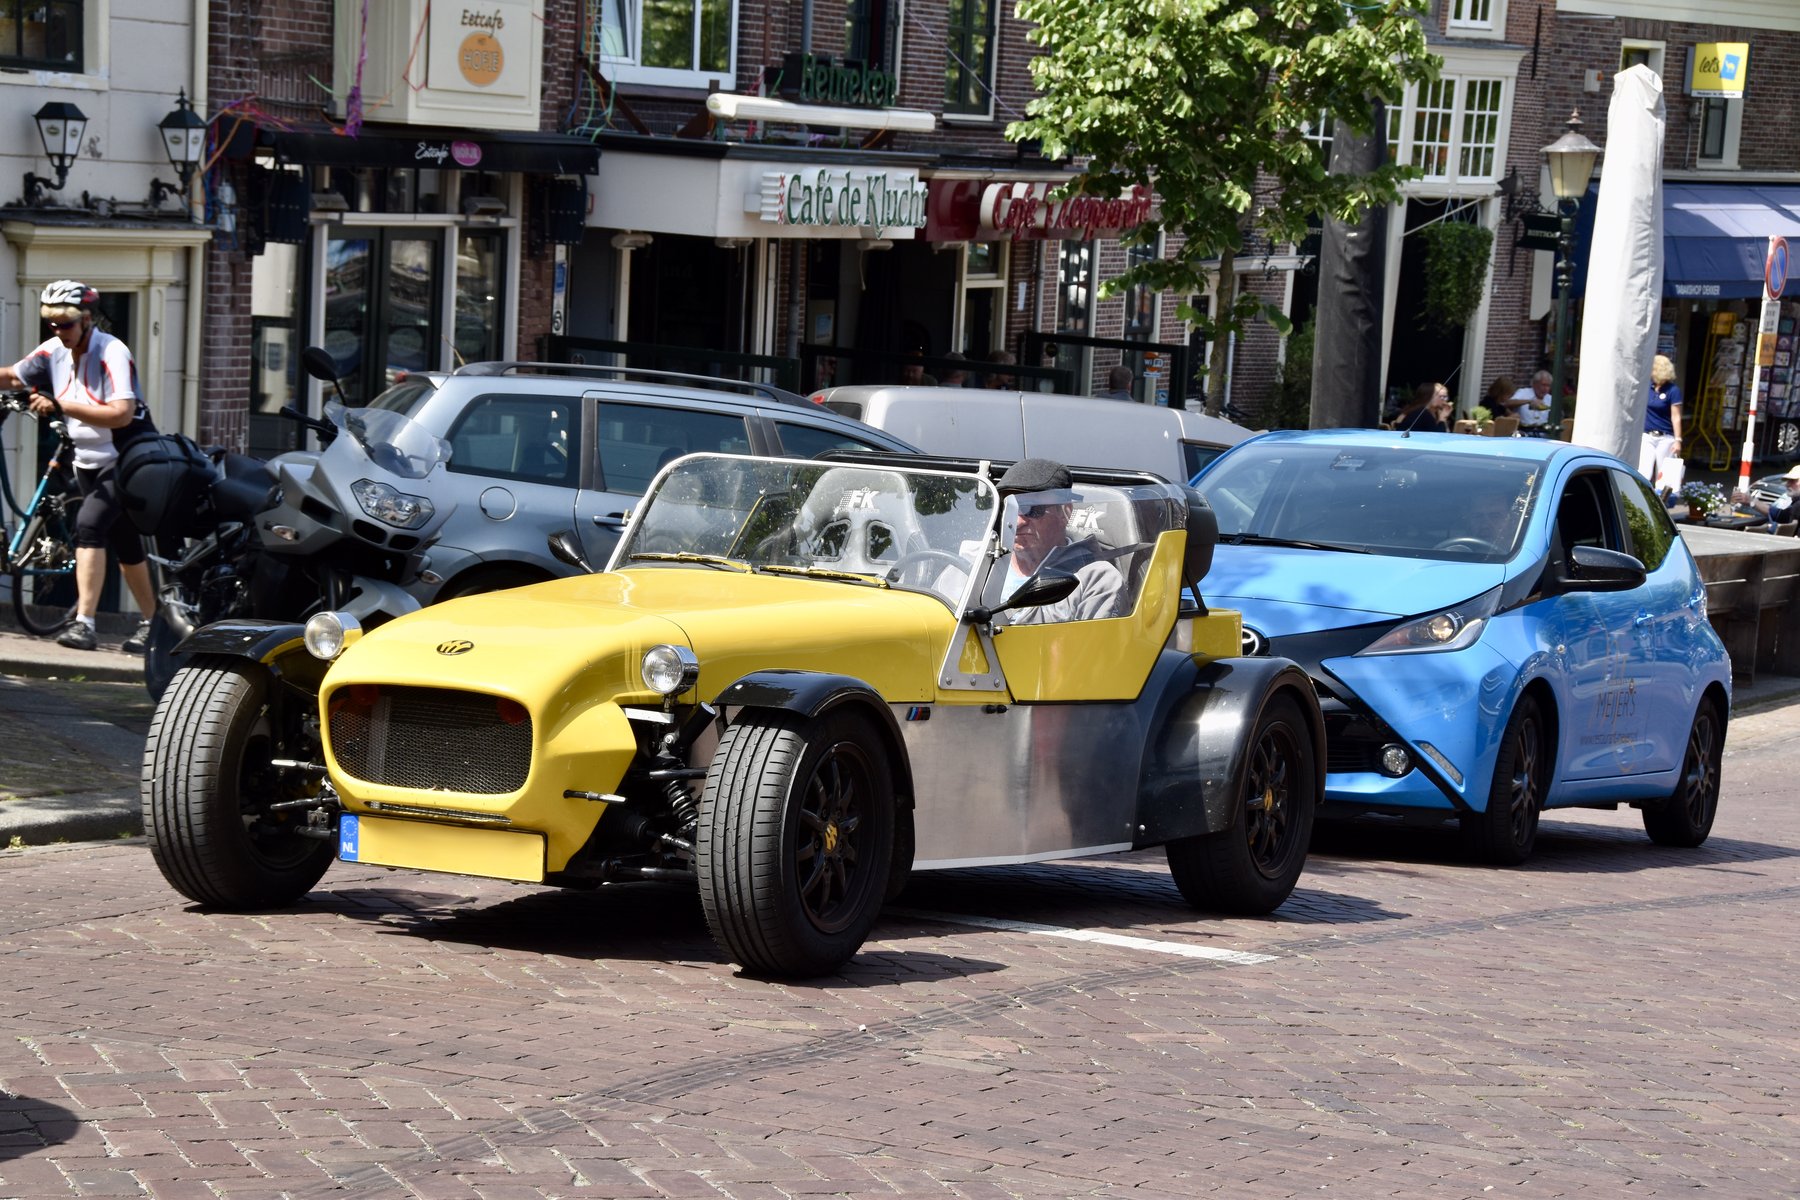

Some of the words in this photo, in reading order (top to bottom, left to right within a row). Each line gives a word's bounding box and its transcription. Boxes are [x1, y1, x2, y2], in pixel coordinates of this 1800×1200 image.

[801, 53, 897, 106] Heineken
[786, 168, 833, 226] Café
[838, 170, 861, 227] de
[864, 171, 928, 240] Klucht
[847, 489, 880, 509] FK
[1071, 509, 1106, 529] FK
[342, 841, 357, 854] NL
